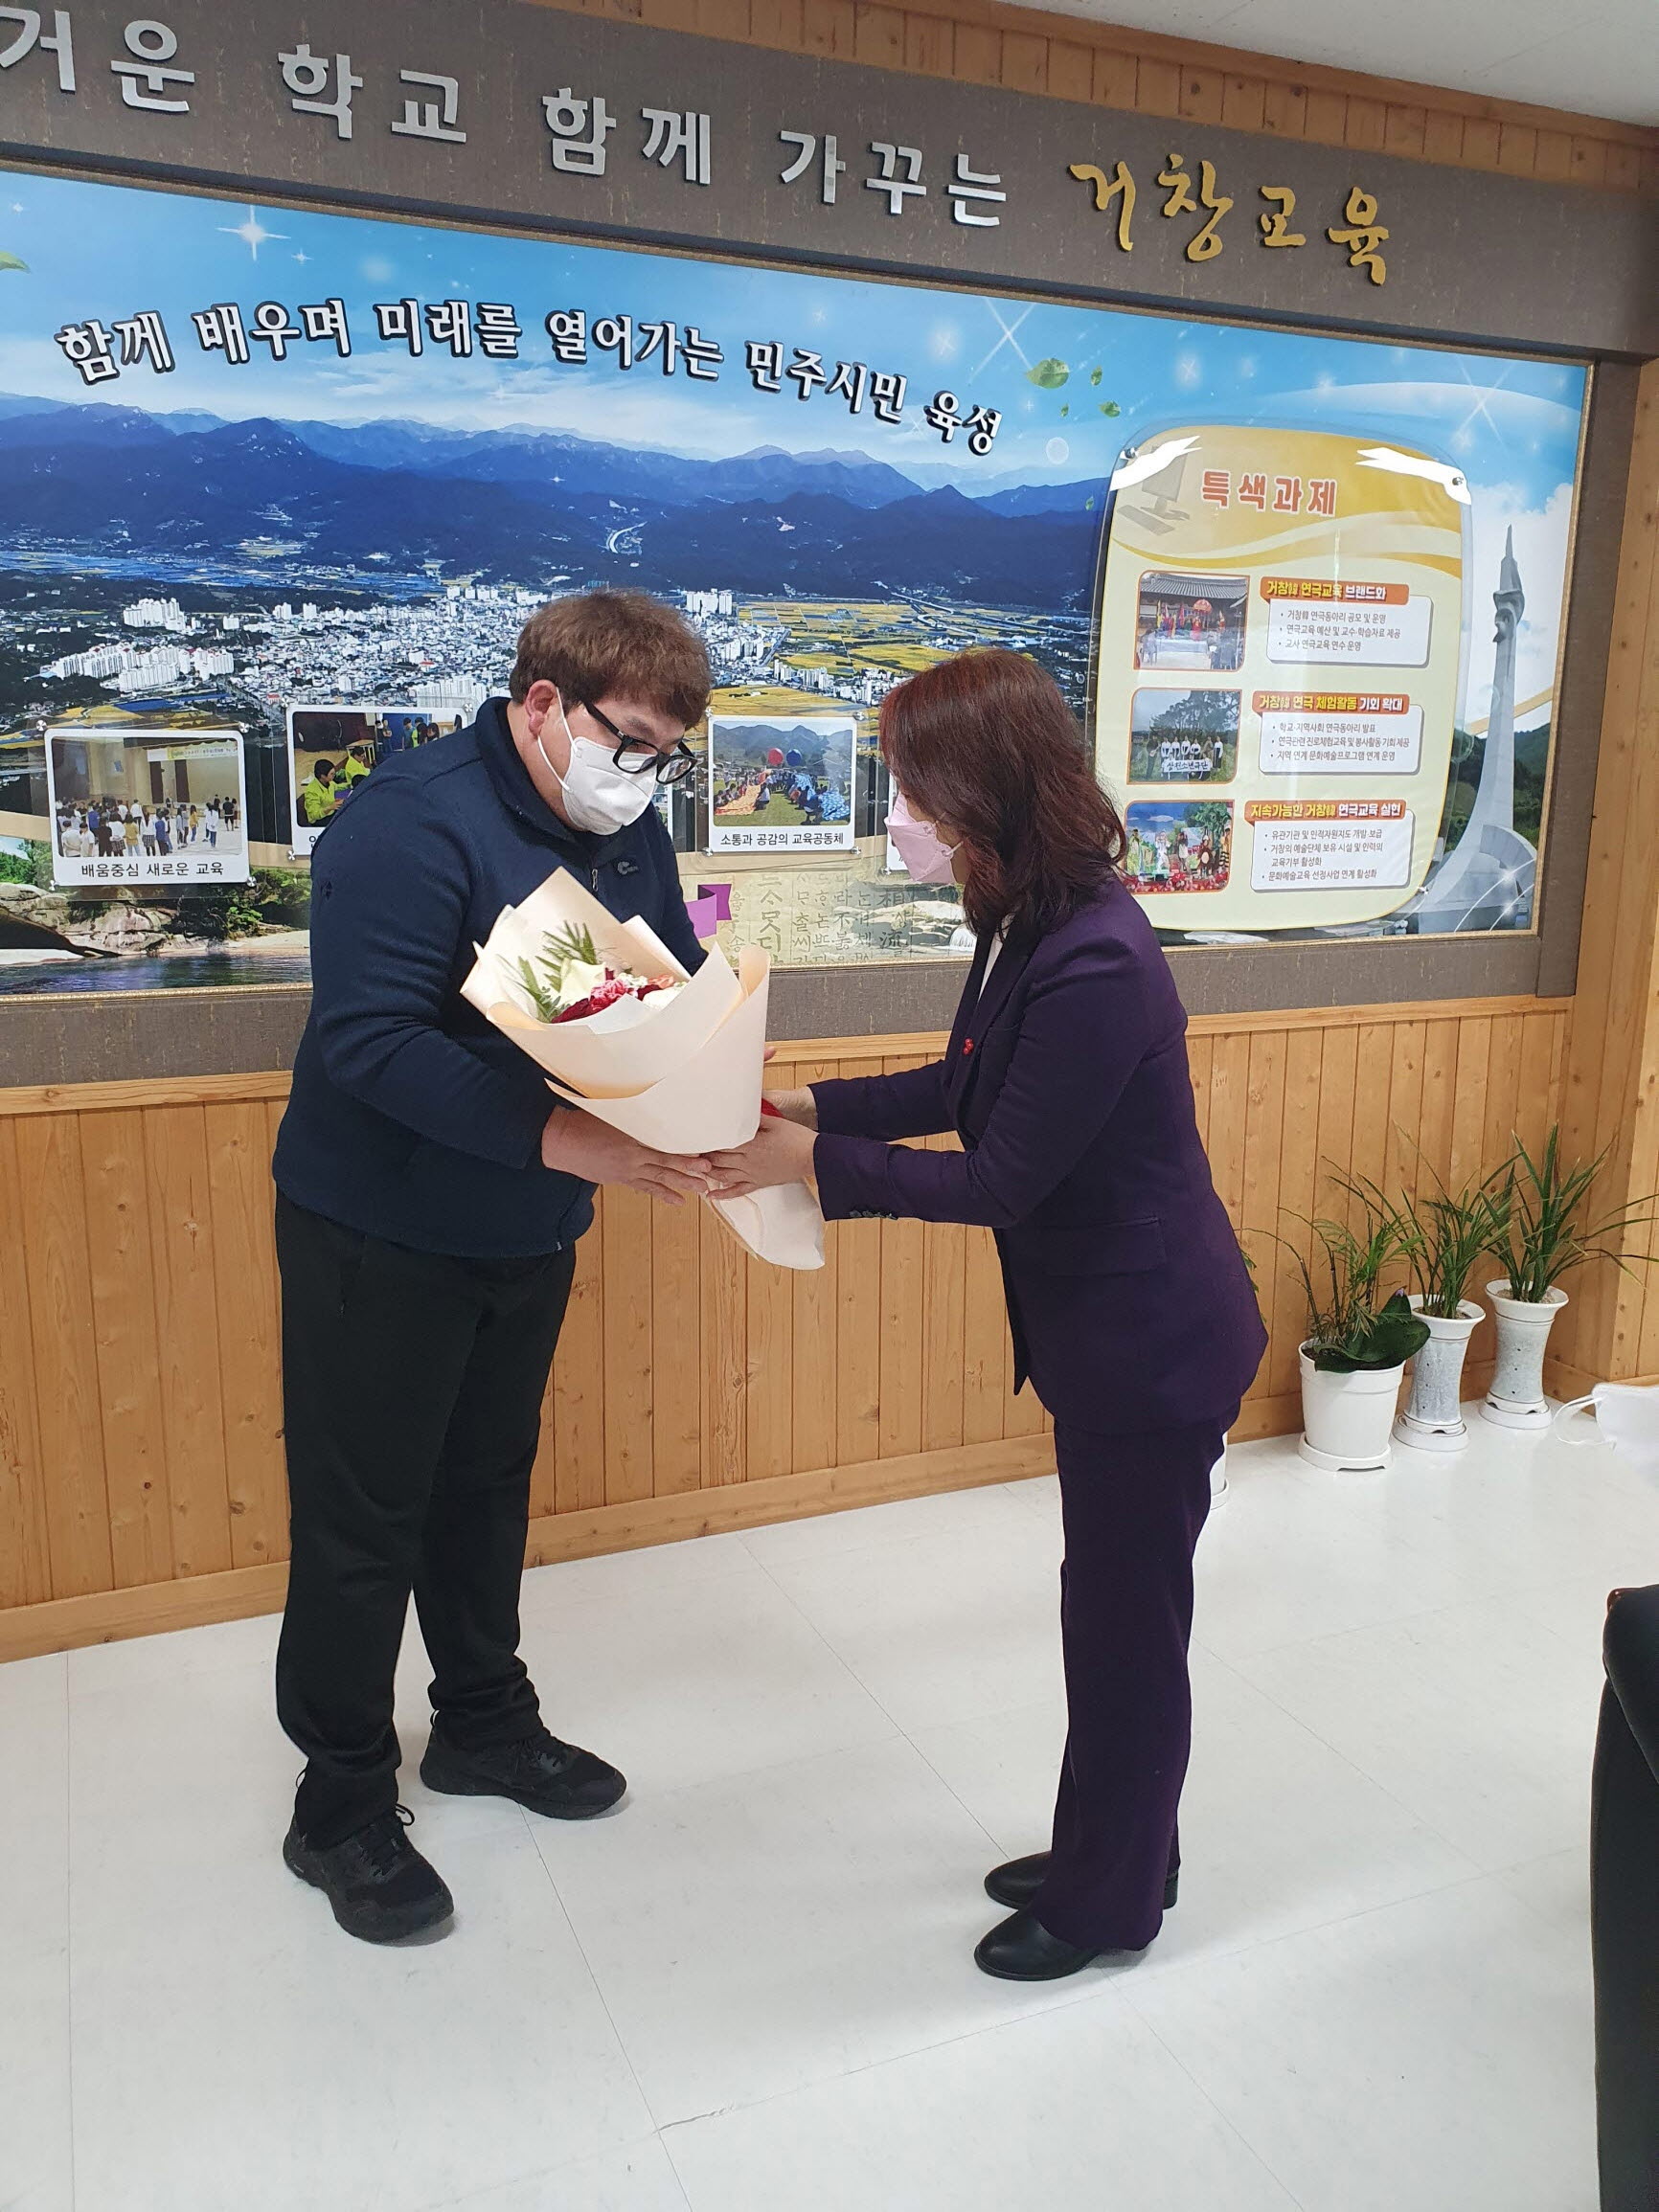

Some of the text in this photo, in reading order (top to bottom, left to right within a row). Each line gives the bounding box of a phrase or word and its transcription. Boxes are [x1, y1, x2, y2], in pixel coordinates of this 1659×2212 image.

[278, 43, 466, 143] 학교
[542, 87, 712, 185] 함께
[780, 129, 1007, 227] 가꾸는
[1069, 153, 1390, 285] 거창교육
[55, 297, 1003, 457] 함께 배우며 미래를 열어가는 민주시민 육성
[1200, 469, 1337, 516] 특색과제
[1301, 582, 1343, 598] 연극교육
[1345, 585, 1386, 600] 브랜드화
[1311, 611, 1346, 622] 연극동아리
[1348, 613, 1361, 623] 공모
[1364, 613, 1371, 623] 및
[1373, 614, 1386, 624] 운영
[1286, 624, 1315, 637] 연극교육
[1317, 625, 1330, 637] 예산
[1332, 626, 1339, 637] 및
[1387, 628, 1400, 639] 제공
[1285, 639, 1361, 651] 교사 연극교육 연수 운영
[1293, 696, 1314, 710] 연극
[1316, 696, 1357, 711] 체험활동
[1359, 697, 1379, 711] 기회
[1382, 697, 1403, 711] 확대
[1326, 723, 1360, 734] 연극동아리
[1363, 724, 1375, 734] 발표
[1278, 736, 1410, 748] 연극관련 진로체험교육 및 봉사활동 기회 제공
[1278, 751, 1396, 761] 지역 연계 문화예술프로그램 연계 운영
[1251, 803, 1303, 818] 지속가능한
[1338, 802, 1377, 817] 연극교육
[1380, 802, 1400, 817] 실현
[720, 831, 844, 846] 소통과 공감의 교육공동체
[1271, 830, 1300, 841] 유관기관
[1302, 830, 1308, 840] 및
[1270, 842, 1383, 854] 거창의 예술단체 보유 시설 및 인력의
[1271, 857, 1322, 868] 교육기부 활성화
[81, 862, 224, 878] 배움중심 새로운 교육
[1268, 869, 1377, 882] 문화예술교육 선정사업 연계 활성화
